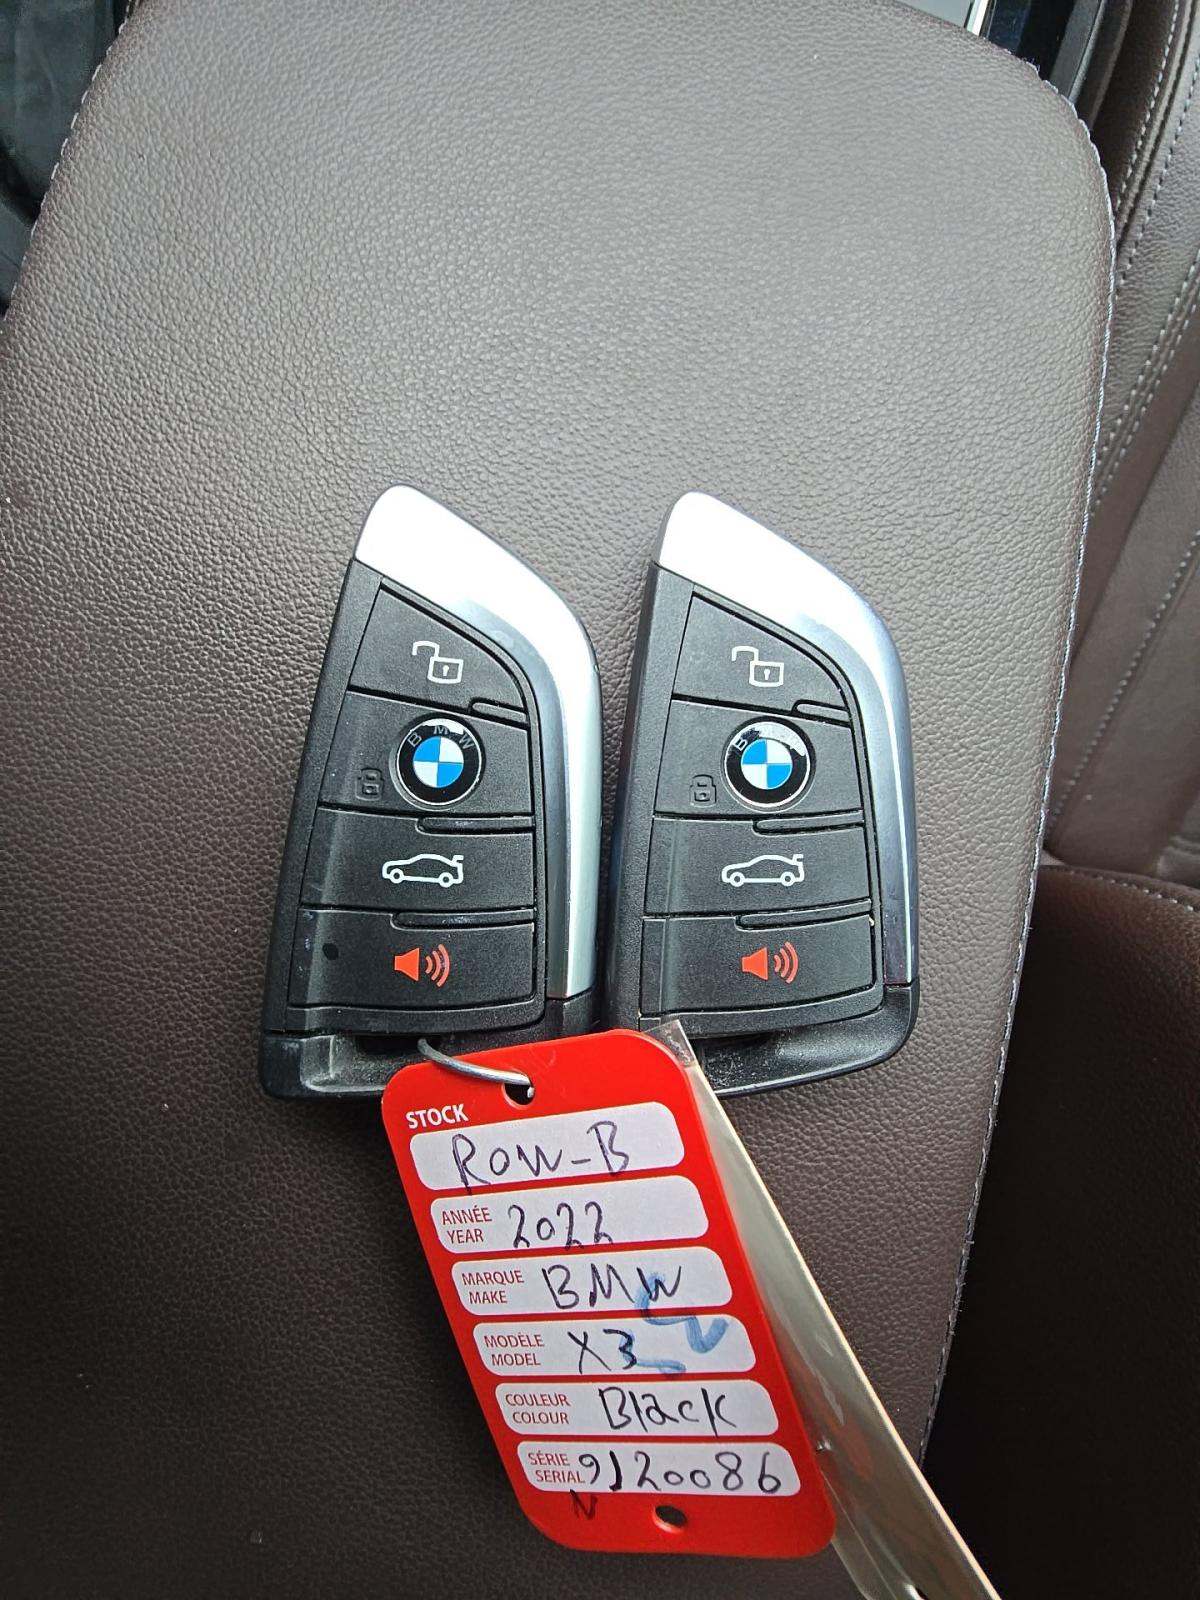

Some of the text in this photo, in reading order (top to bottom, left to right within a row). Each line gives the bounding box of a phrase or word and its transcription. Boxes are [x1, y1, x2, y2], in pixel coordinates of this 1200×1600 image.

[405, 1103, 469, 1130] STOCK
[441, 1203, 493, 1225] ANNÉE
[507, 1201, 614, 1249] 2022
[446, 1228, 484, 1246] YEAR
[461, 1269, 525, 1287] MARQUE
[542, 1263, 682, 1310] BMW
[469, 1289, 508, 1305] MAKE
[484, 1331, 544, 1349] MODÈLE
[491, 1351, 541, 1367] MODEL
[567, 1328, 638, 1374] X3
[505, 1391, 571, 1408] COULEUR
[512, 1409, 570, 1425] COLOUR
[598, 1386, 737, 1438] Black
[527, 1450, 570, 1467] SÉRIE
[534, 1468, 586, 1485] SERIAL
